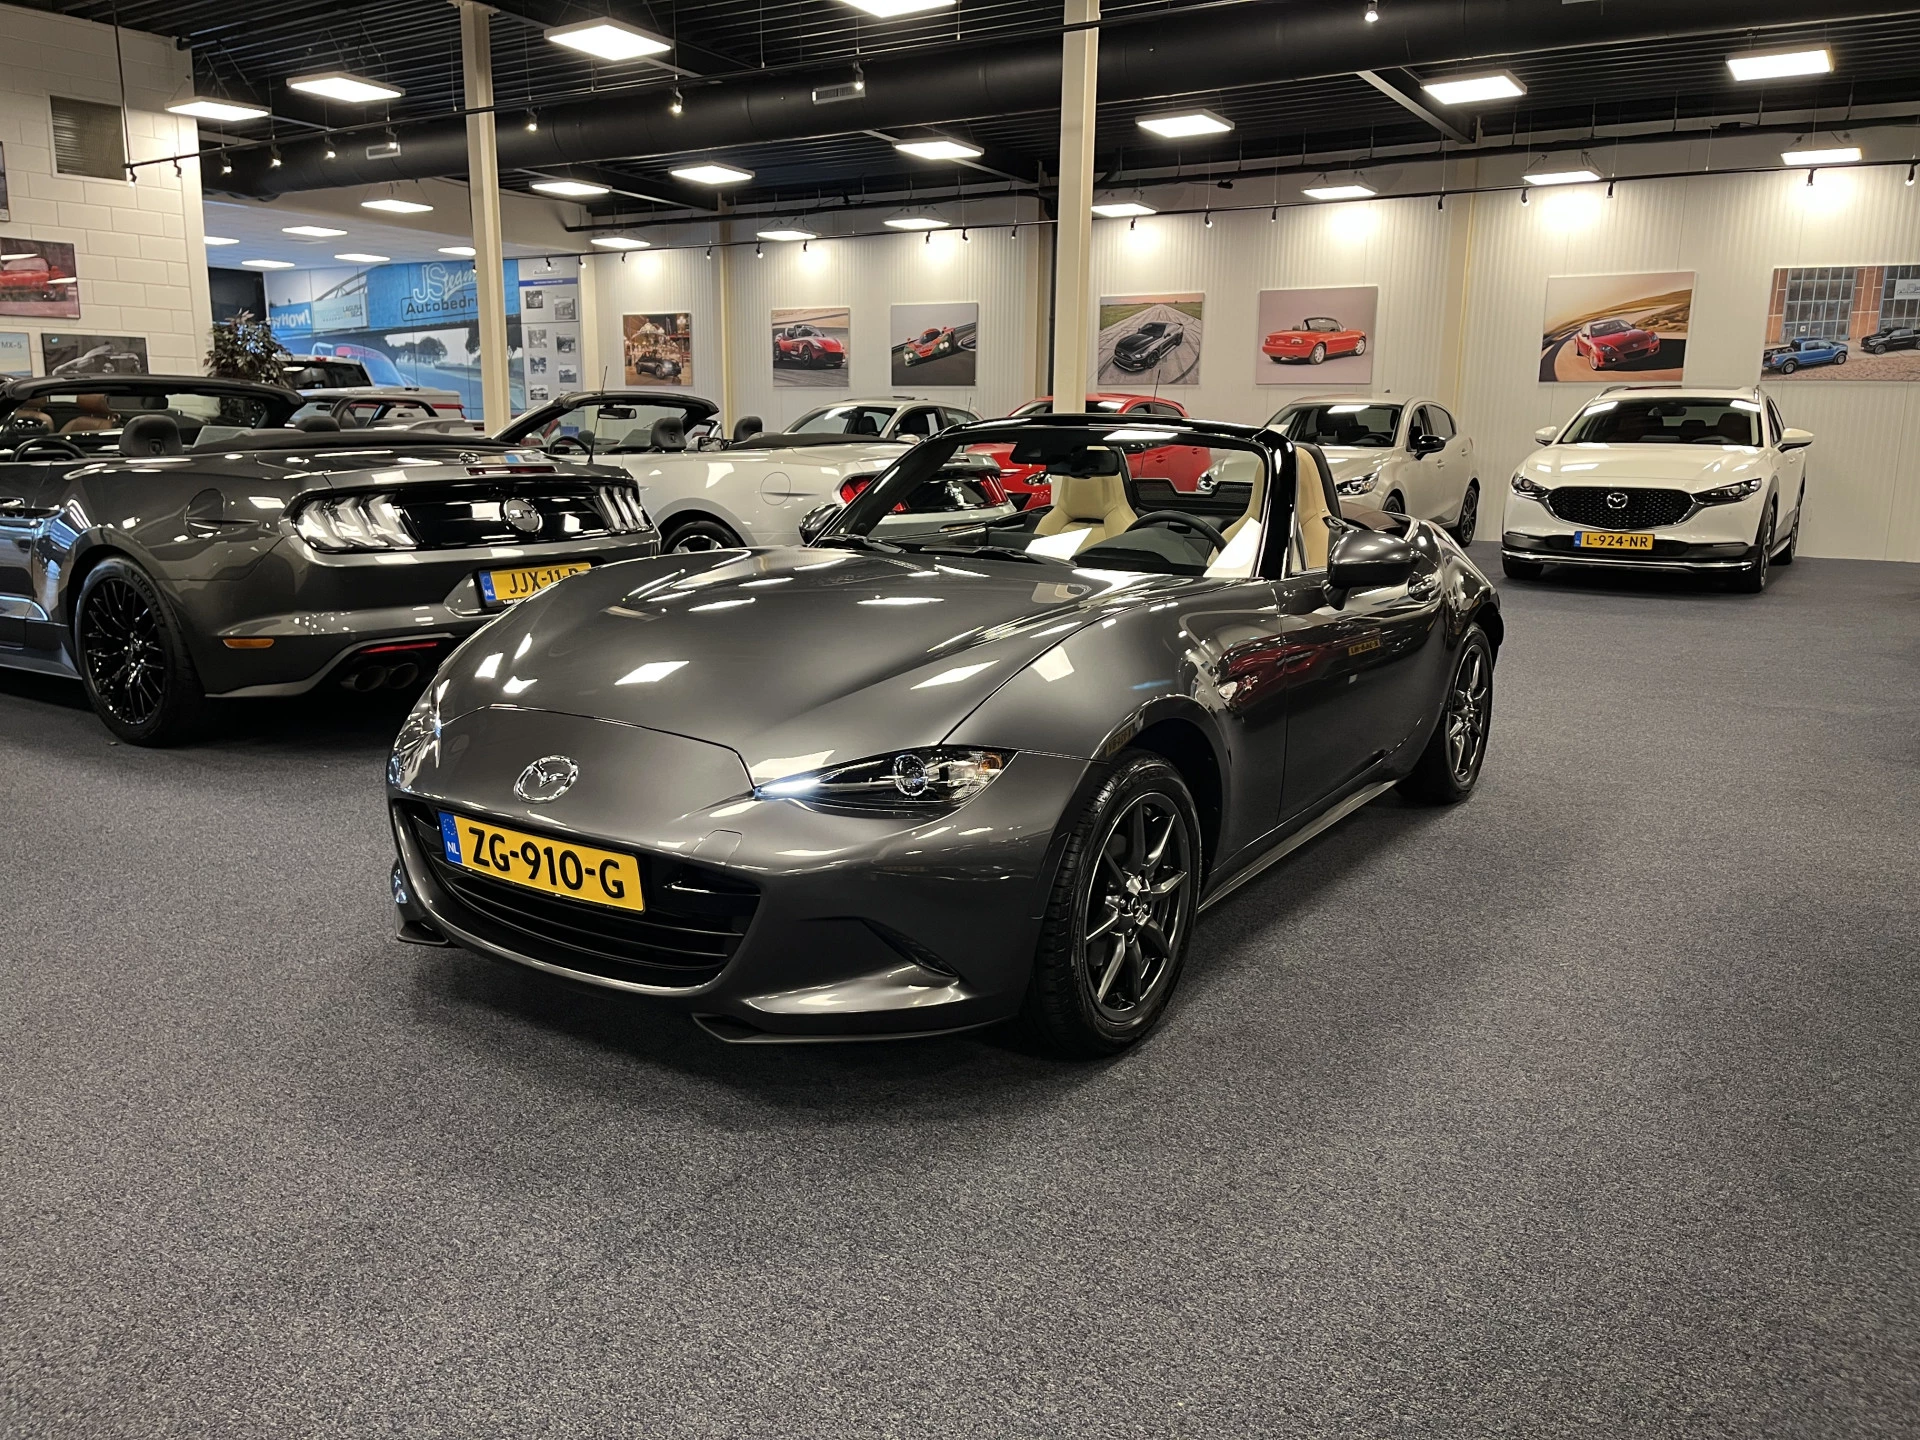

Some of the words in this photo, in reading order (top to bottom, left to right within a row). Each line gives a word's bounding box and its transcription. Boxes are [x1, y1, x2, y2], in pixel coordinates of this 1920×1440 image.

[1586, 534, 1648, 547] L-924-NR
[447, 840, 460, 855] NL
[468, 826, 625, 899] ZG-910-G
